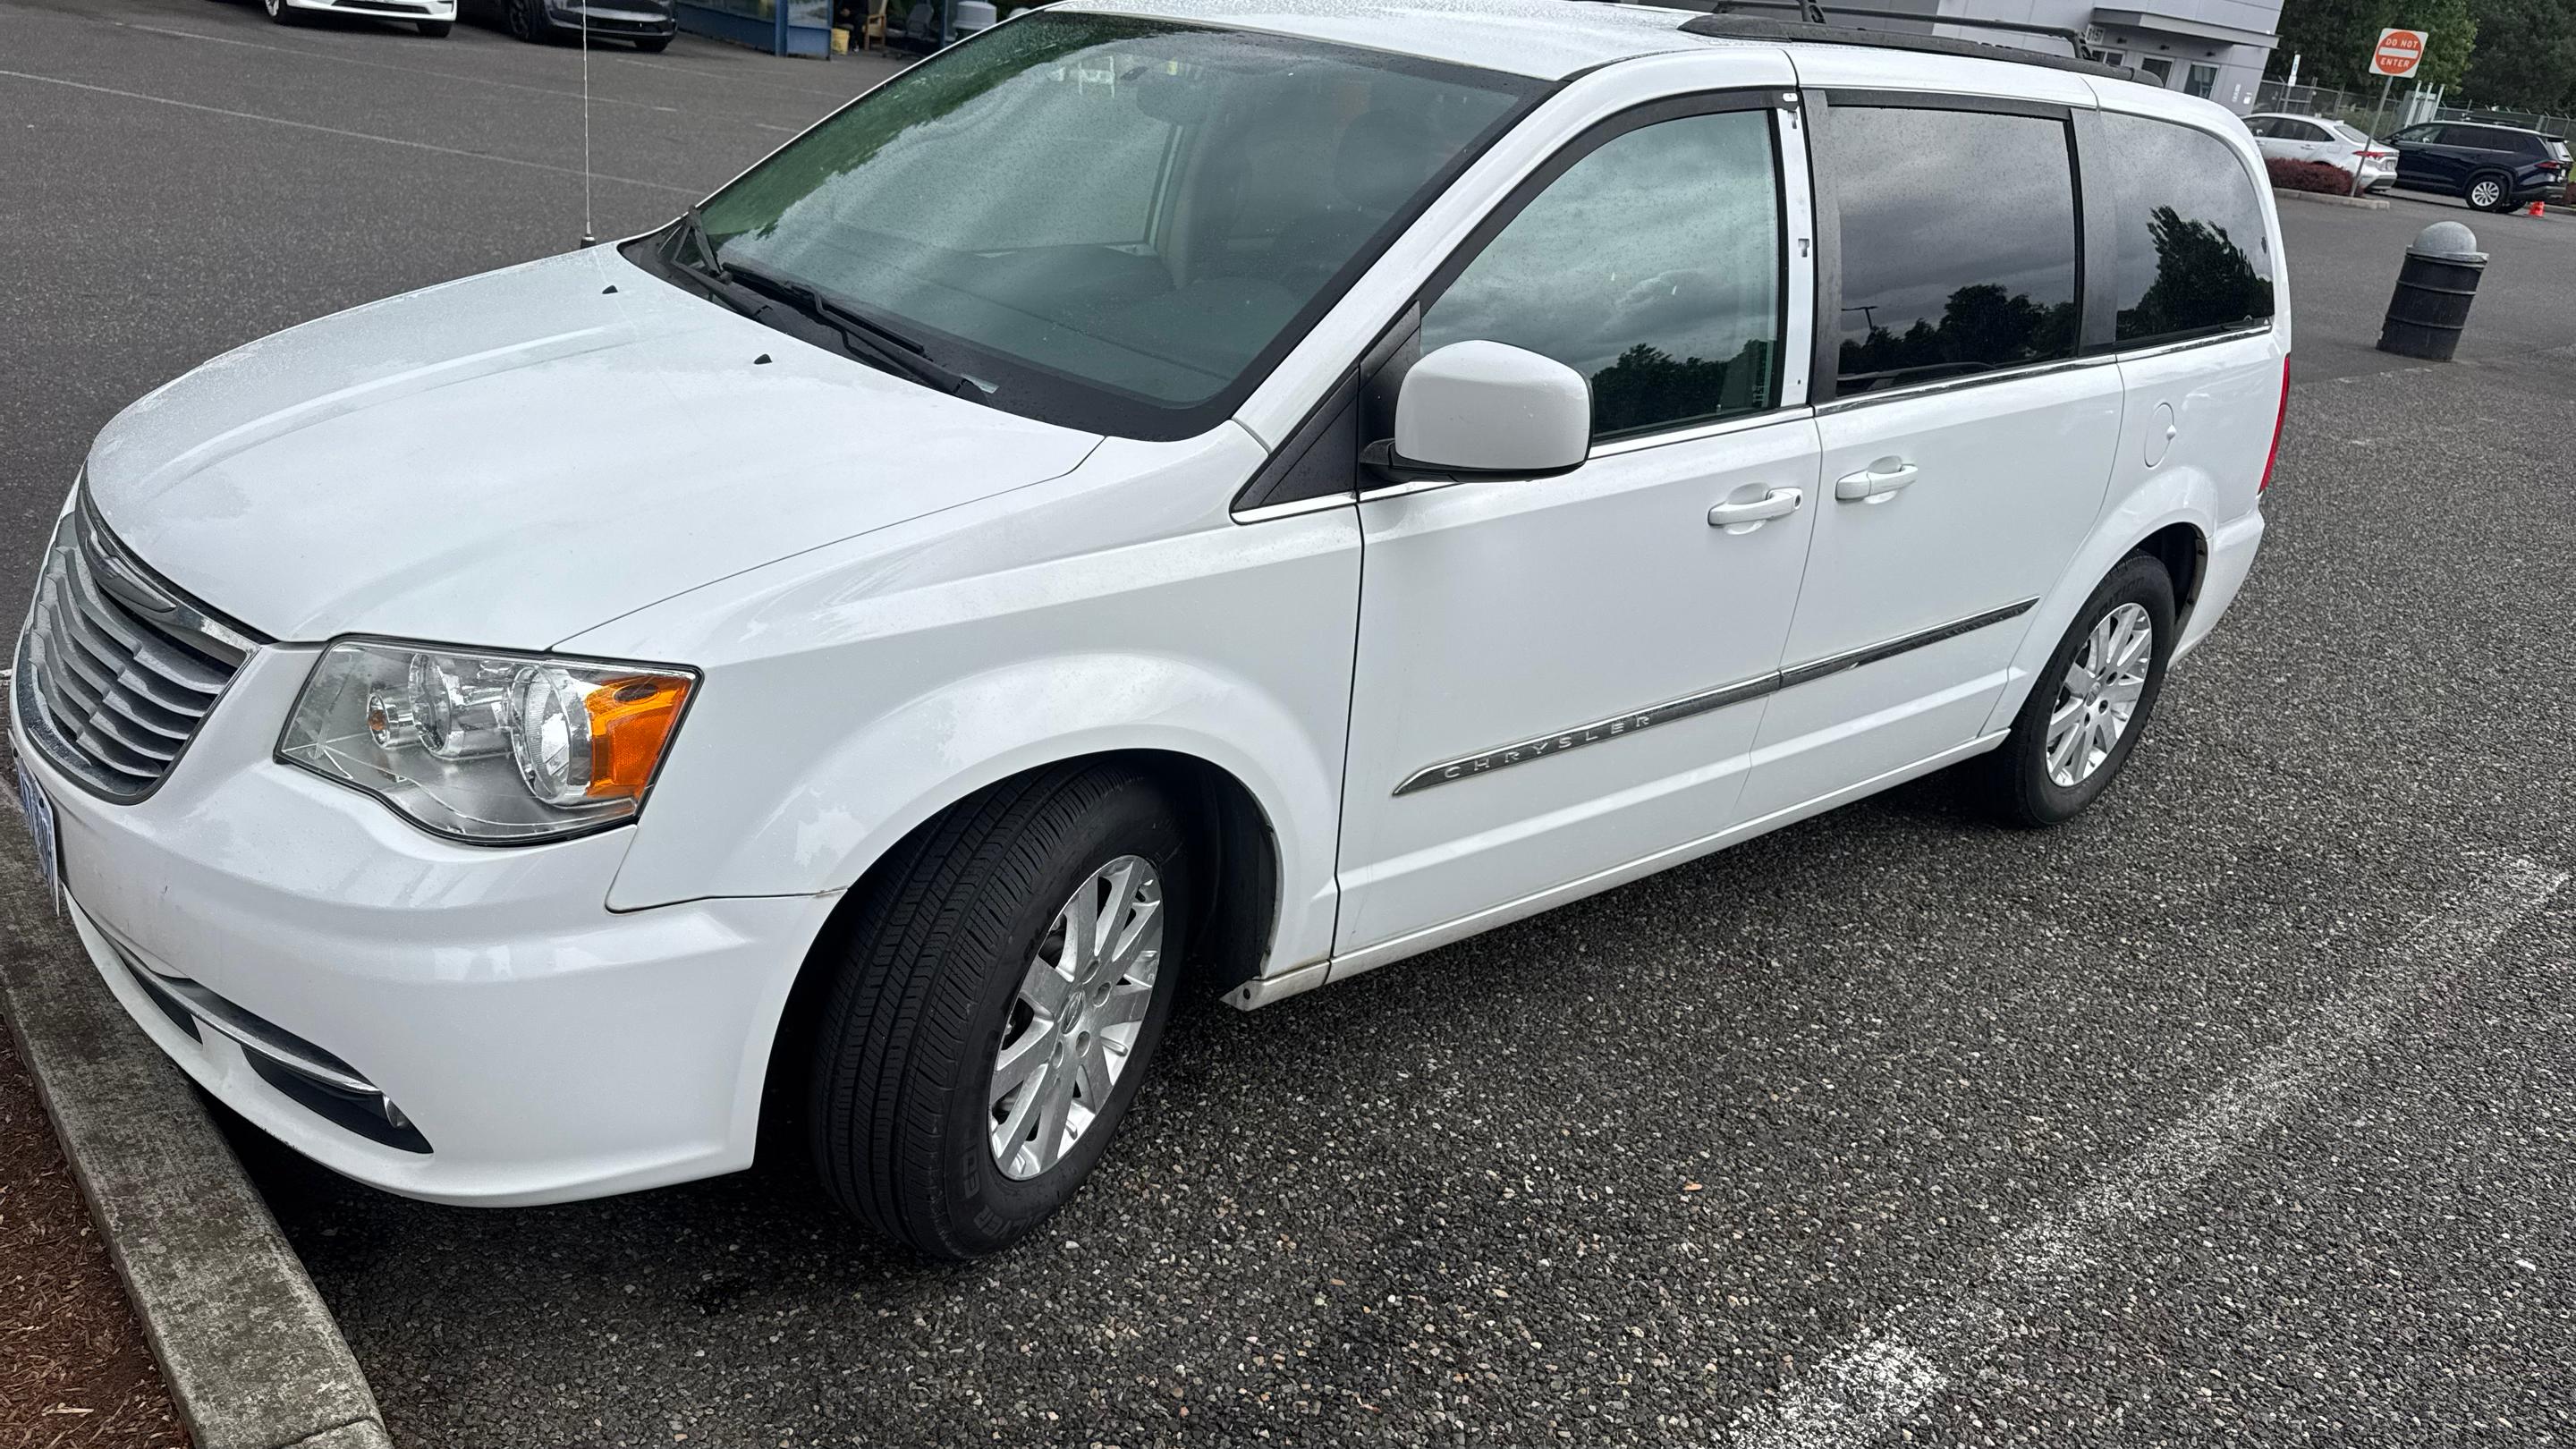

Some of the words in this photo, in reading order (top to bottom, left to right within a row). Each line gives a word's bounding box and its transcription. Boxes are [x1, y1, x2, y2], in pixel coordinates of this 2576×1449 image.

[2385, 38, 2397, 47] DO
[2400, 39, 2419, 48] NOT
[2380, 57, 2410, 68] ENTER
[1444, 715, 1650, 778] CHRYSLER
